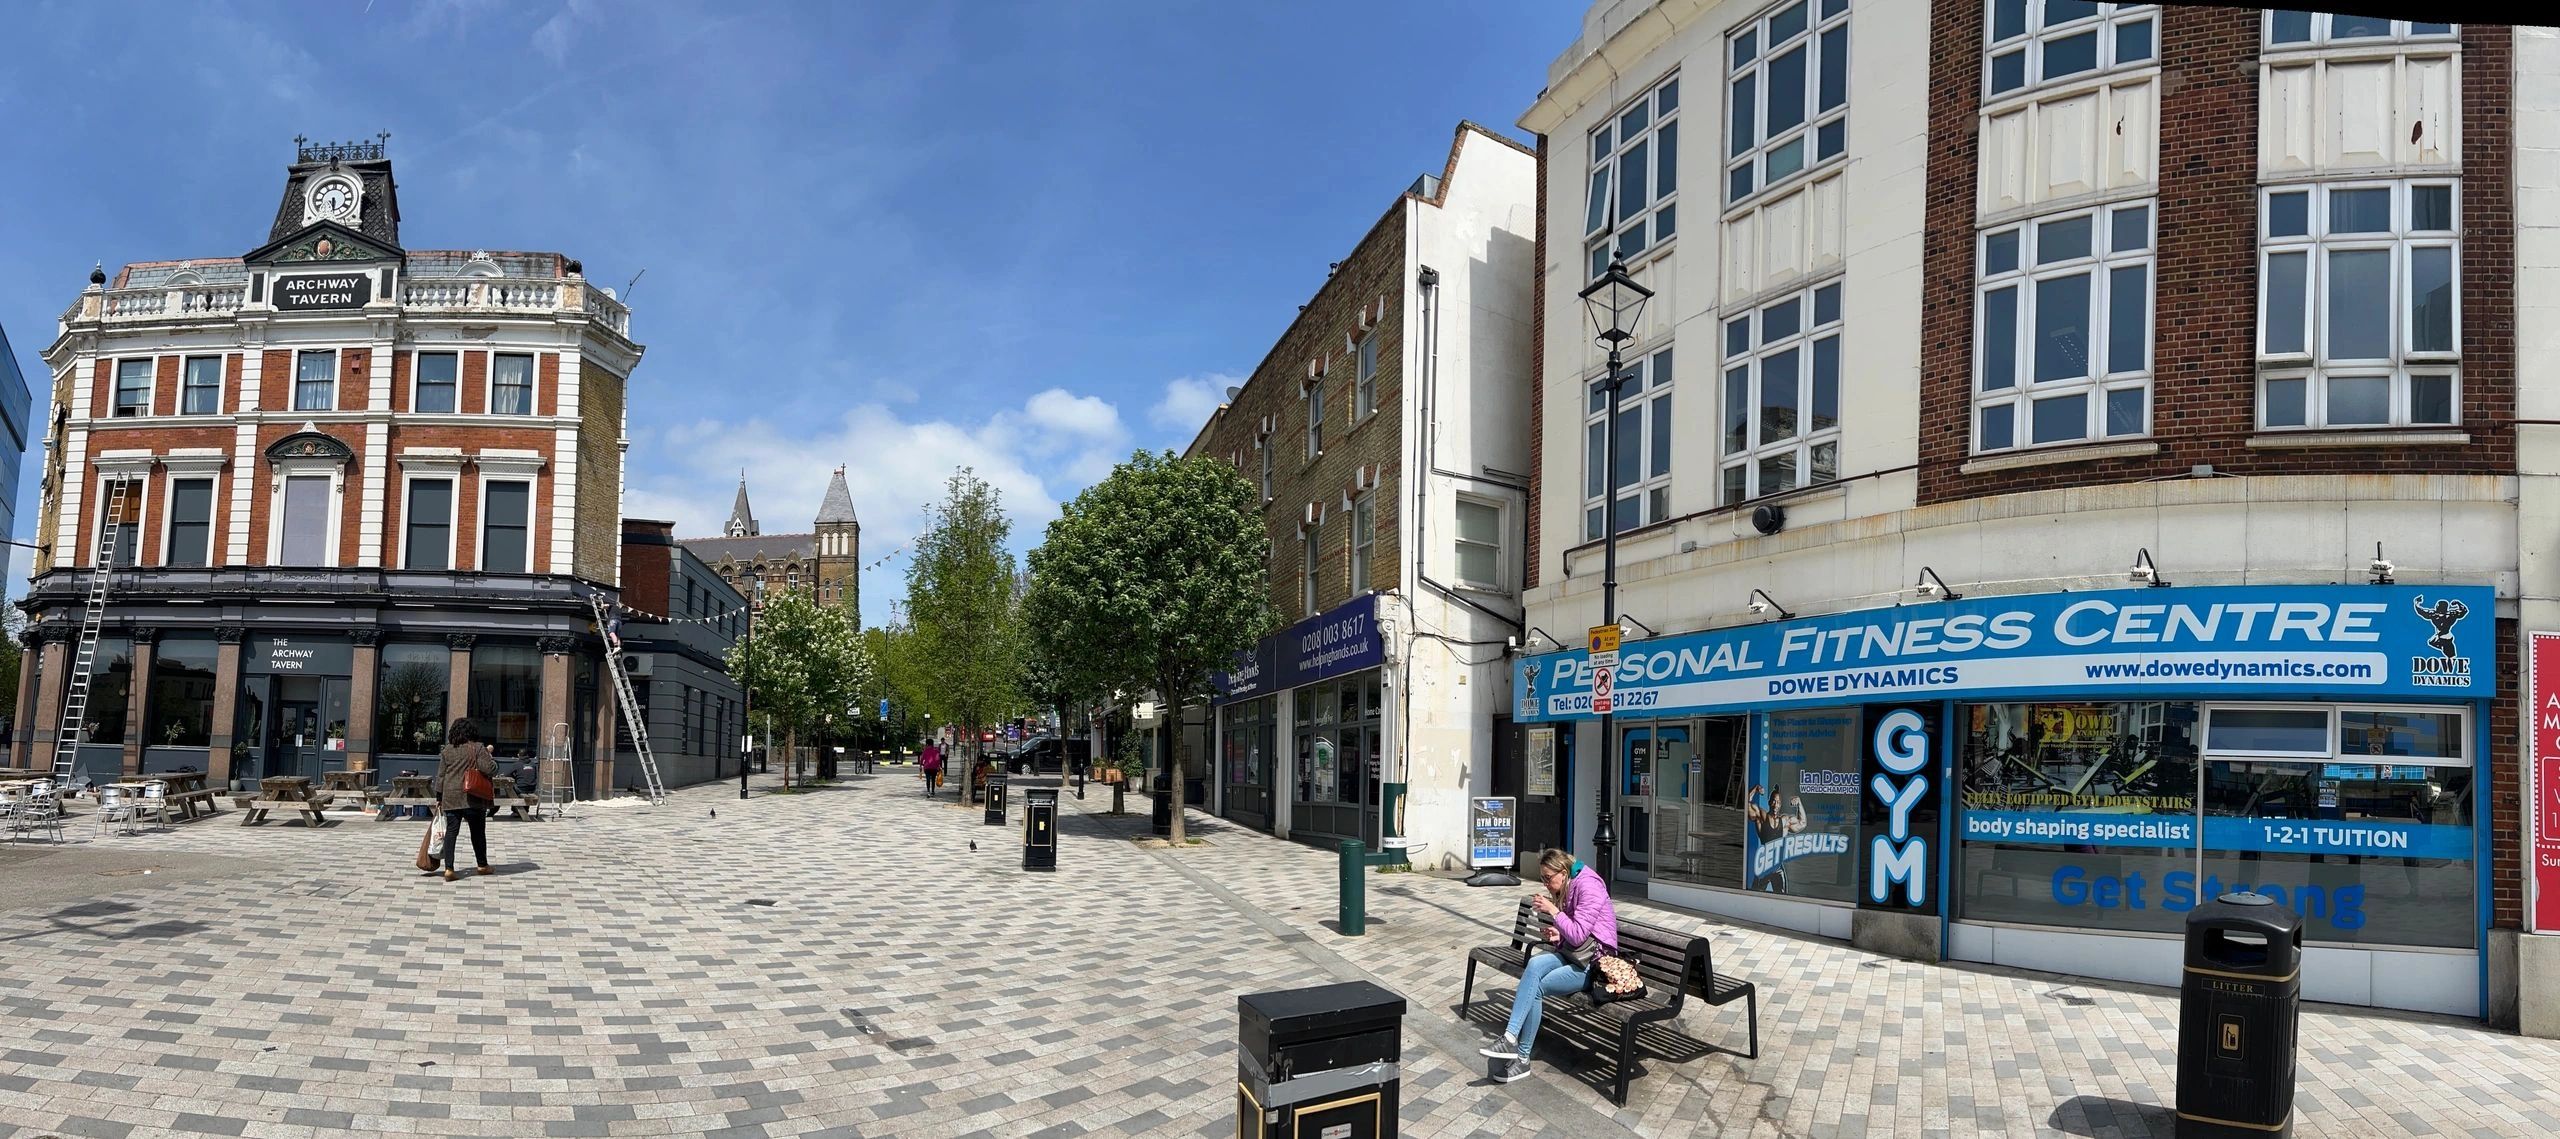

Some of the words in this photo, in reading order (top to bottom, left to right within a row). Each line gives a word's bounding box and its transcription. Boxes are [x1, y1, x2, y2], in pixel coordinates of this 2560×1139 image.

[286, 278, 359, 290] ARCHWAY
[290, 293, 352, 304] TAVERN
[273, 638, 288, 646] THE
[1302, 630, 1321, 653] 0208
[1323, 622, 1339, 646] 003
[1342, 613, 1365, 638] 8617
[1777, 611, 2036, 667] FITNESS
[2053, 599, 2388, 646] CENTRE
[272, 649, 314, 658] ARCHWAY
[1299, 636, 1369, 671] www.helpinghands.co.uk
[271, 660, 303, 669] TAVERN
[2085, 658, 2371, 681] www.dowedynamics.com
[2412, 656, 2470, 676] DOWE
[1768, 676, 1829, 695] DOWE
[1834, 666, 1959, 691] DYNAMICS
[2412, 676, 2471, 687] DYNAMICS
[1554, 697, 1571, 711] Tel:
[1627, 691, 1659, 706] 2267
[1634, 747, 1646, 755] GYM
[1800, 769, 1821, 785] Ian
[1822, 769, 1860, 786] Dowe
[1870, 708, 1929, 907] GYM
[1967, 792, 2003, 804] FULLY
[2005, 792, 2070, 806] EQUIPPED
[2072, 793, 2099, 807] GYM
[2102, 795, 2193, 809] DOWNSTAIRS
[1476, 817, 1492, 827] GYM
[1493, 817, 1511, 827] OPEN
[1968, 817, 2012, 837] body
[2015, 818, 2090, 839] shaping
[2093, 821, 2190, 841] specialist
[2264, 825, 2309, 844] 1-2-1
[2313, 827, 2408, 848] TUITION
[1754, 837, 1784, 877] GET
[1784, 832, 1850, 859] RESULTS
[2052, 864, 2147, 910] Get
[2160, 870, 2366, 930] Stong
[2212, 980, 2254, 993] LITTER
